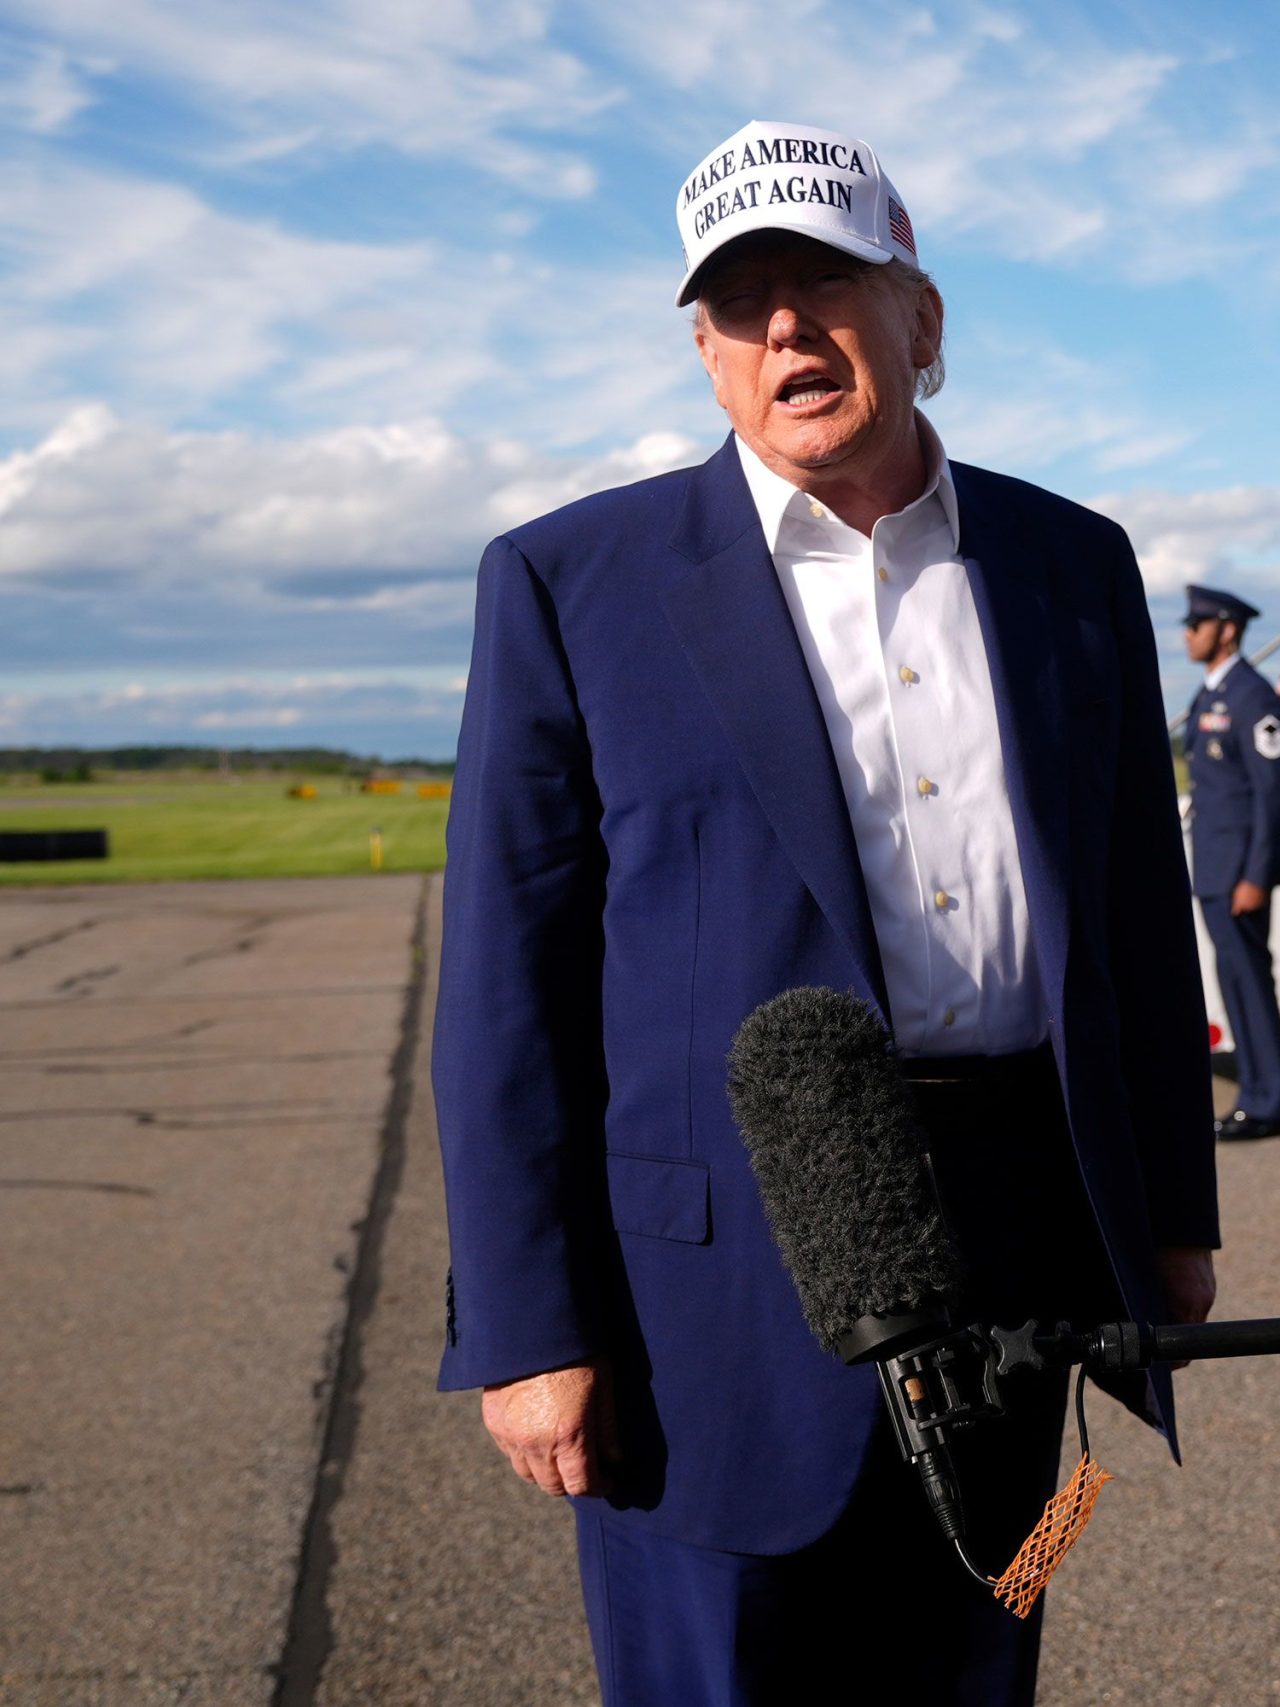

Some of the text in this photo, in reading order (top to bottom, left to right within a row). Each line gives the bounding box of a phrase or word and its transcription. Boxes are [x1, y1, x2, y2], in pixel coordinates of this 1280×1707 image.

[683, 138, 866, 209] MAKE AMERICA
[694, 177, 852, 240] GREAT AGAIN
